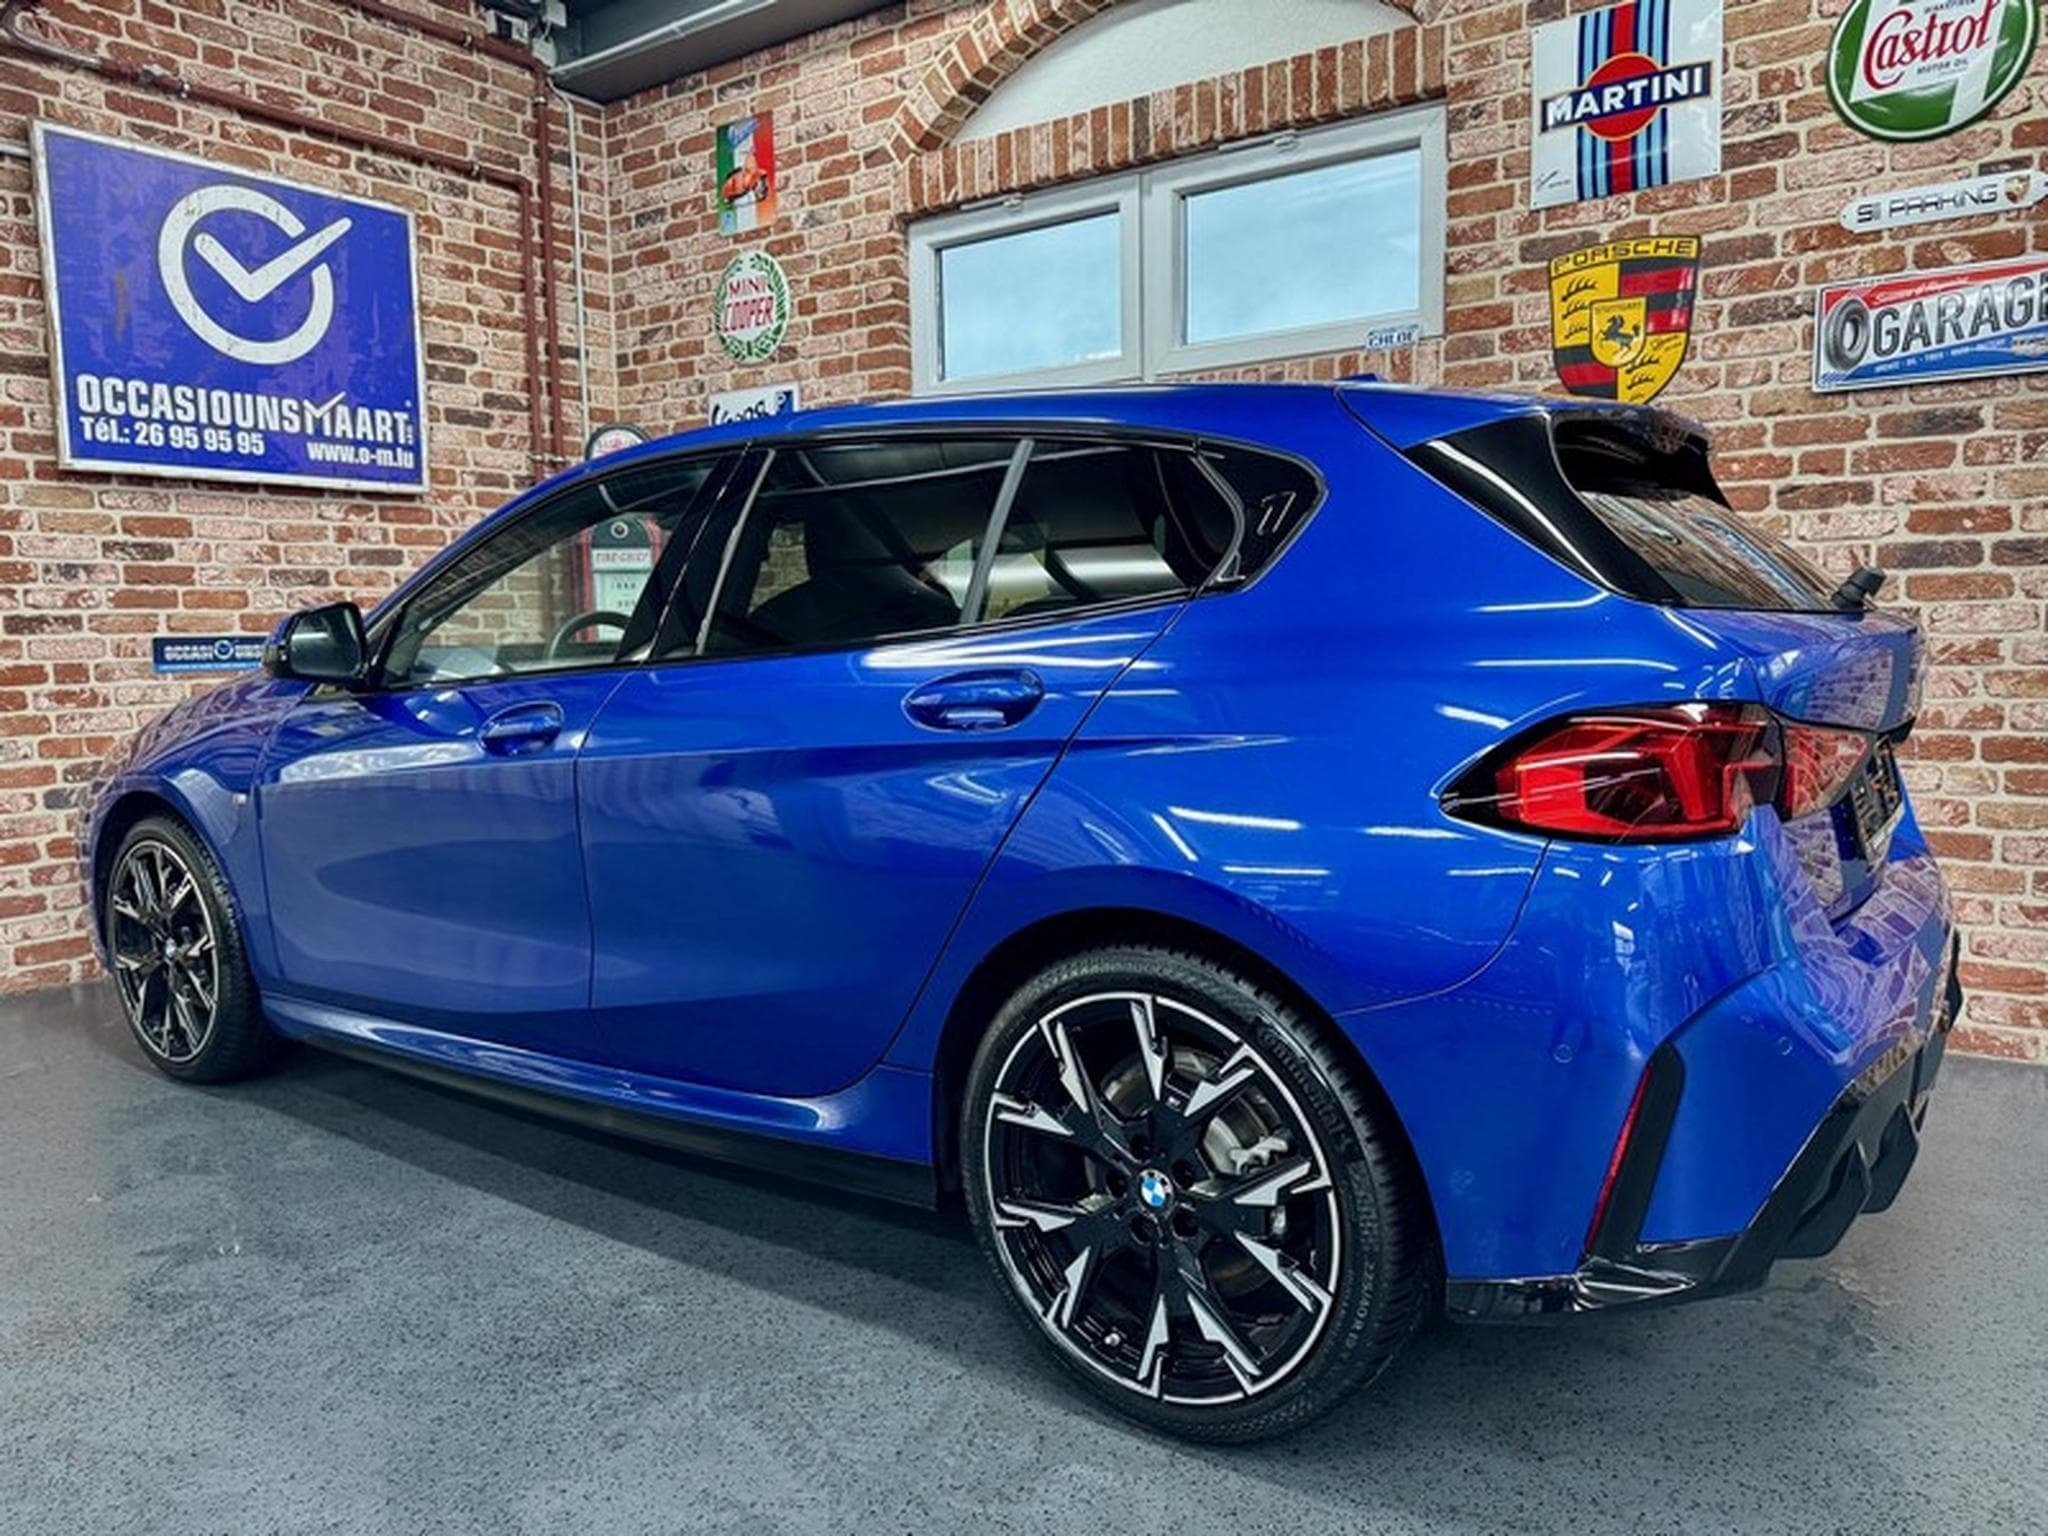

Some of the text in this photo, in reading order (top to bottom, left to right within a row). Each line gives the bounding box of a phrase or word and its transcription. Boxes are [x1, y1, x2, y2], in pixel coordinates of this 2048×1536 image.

[1863, 0, 1999, 90] Castrol
[1547, 66, 1703, 126] MARTINI
[1888, 183, 1999, 217] PARKING
[1553, 239, 1695, 274] PORSCHE
[728, 276, 767, 297] MINI
[723, 295, 774, 333] COOPER
[76, 373, 409, 445] OCCASIOUNSMAART
[79, 415, 265, 456] Tél.: 26 95 95 95
[306, 441, 415, 469] www.o-m.lu
